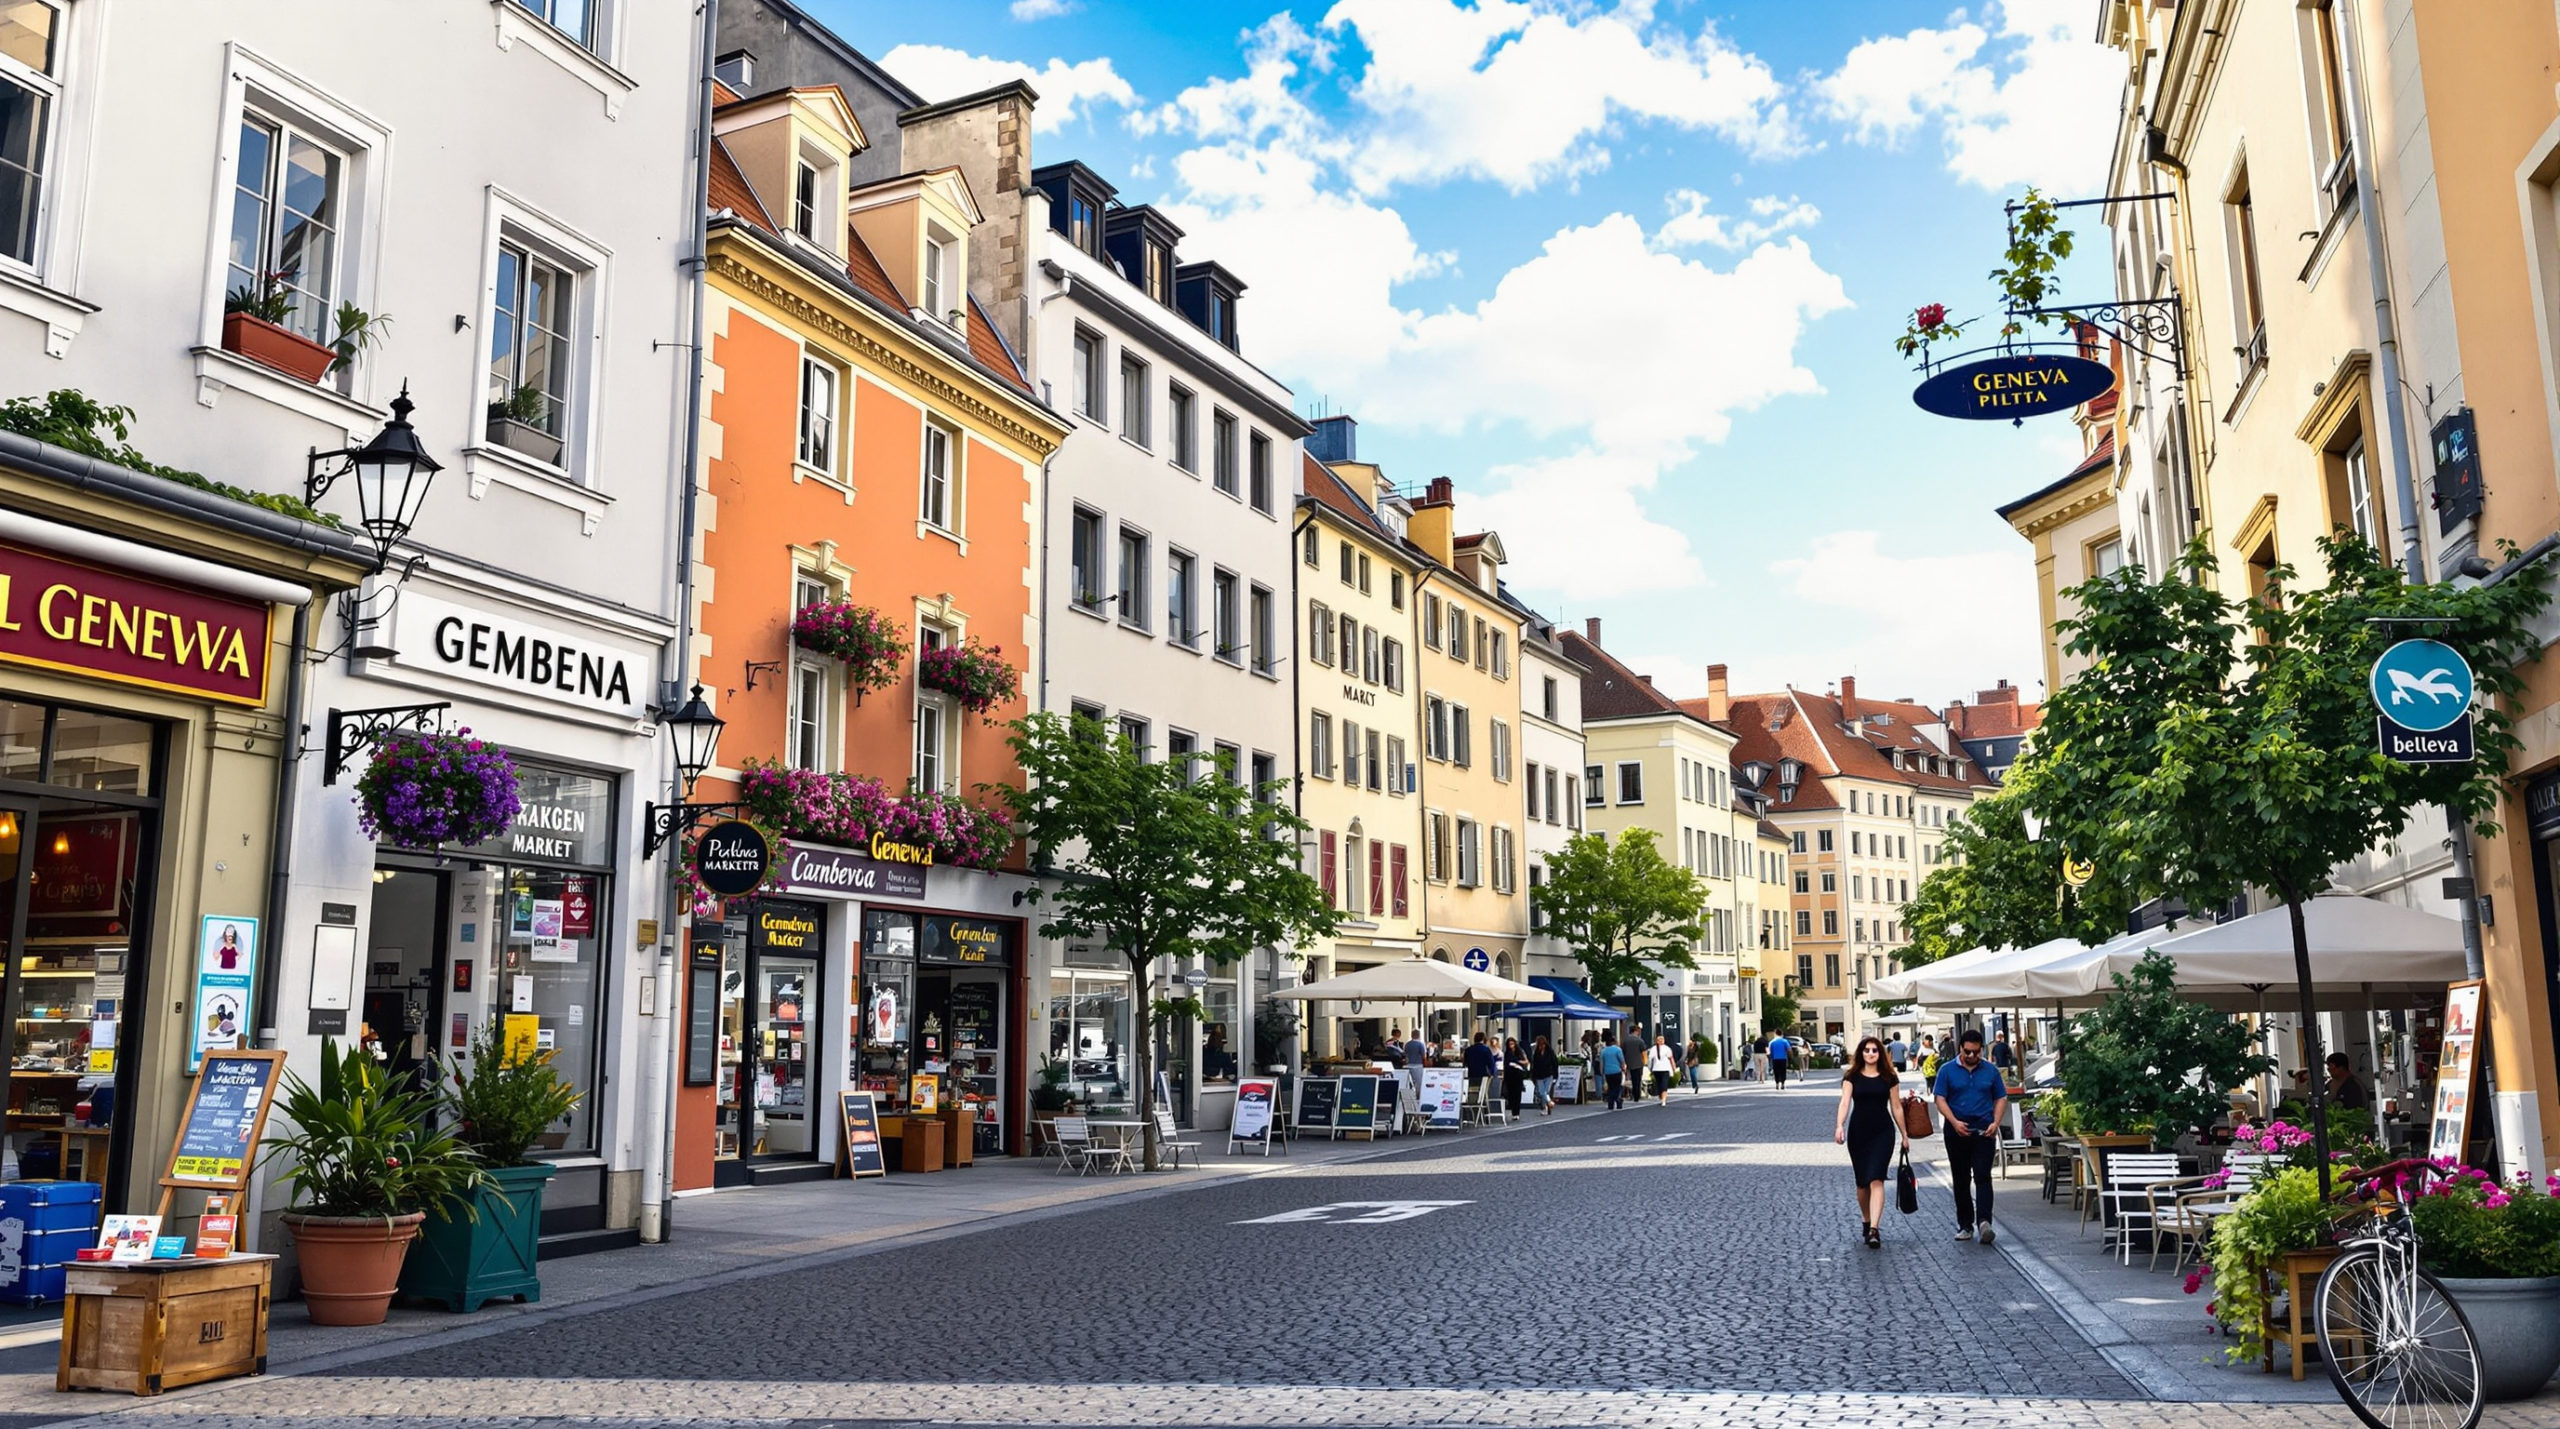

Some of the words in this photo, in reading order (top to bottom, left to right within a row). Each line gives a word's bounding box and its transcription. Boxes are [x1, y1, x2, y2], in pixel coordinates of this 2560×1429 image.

[1973, 368, 2069, 392] GENEVA
[1979, 391, 2048, 408] PILTTA
[435, 616, 631, 705] GEMBENA
[2393, 735, 2459, 753] belleva
[512, 833, 573, 858] MARKET
